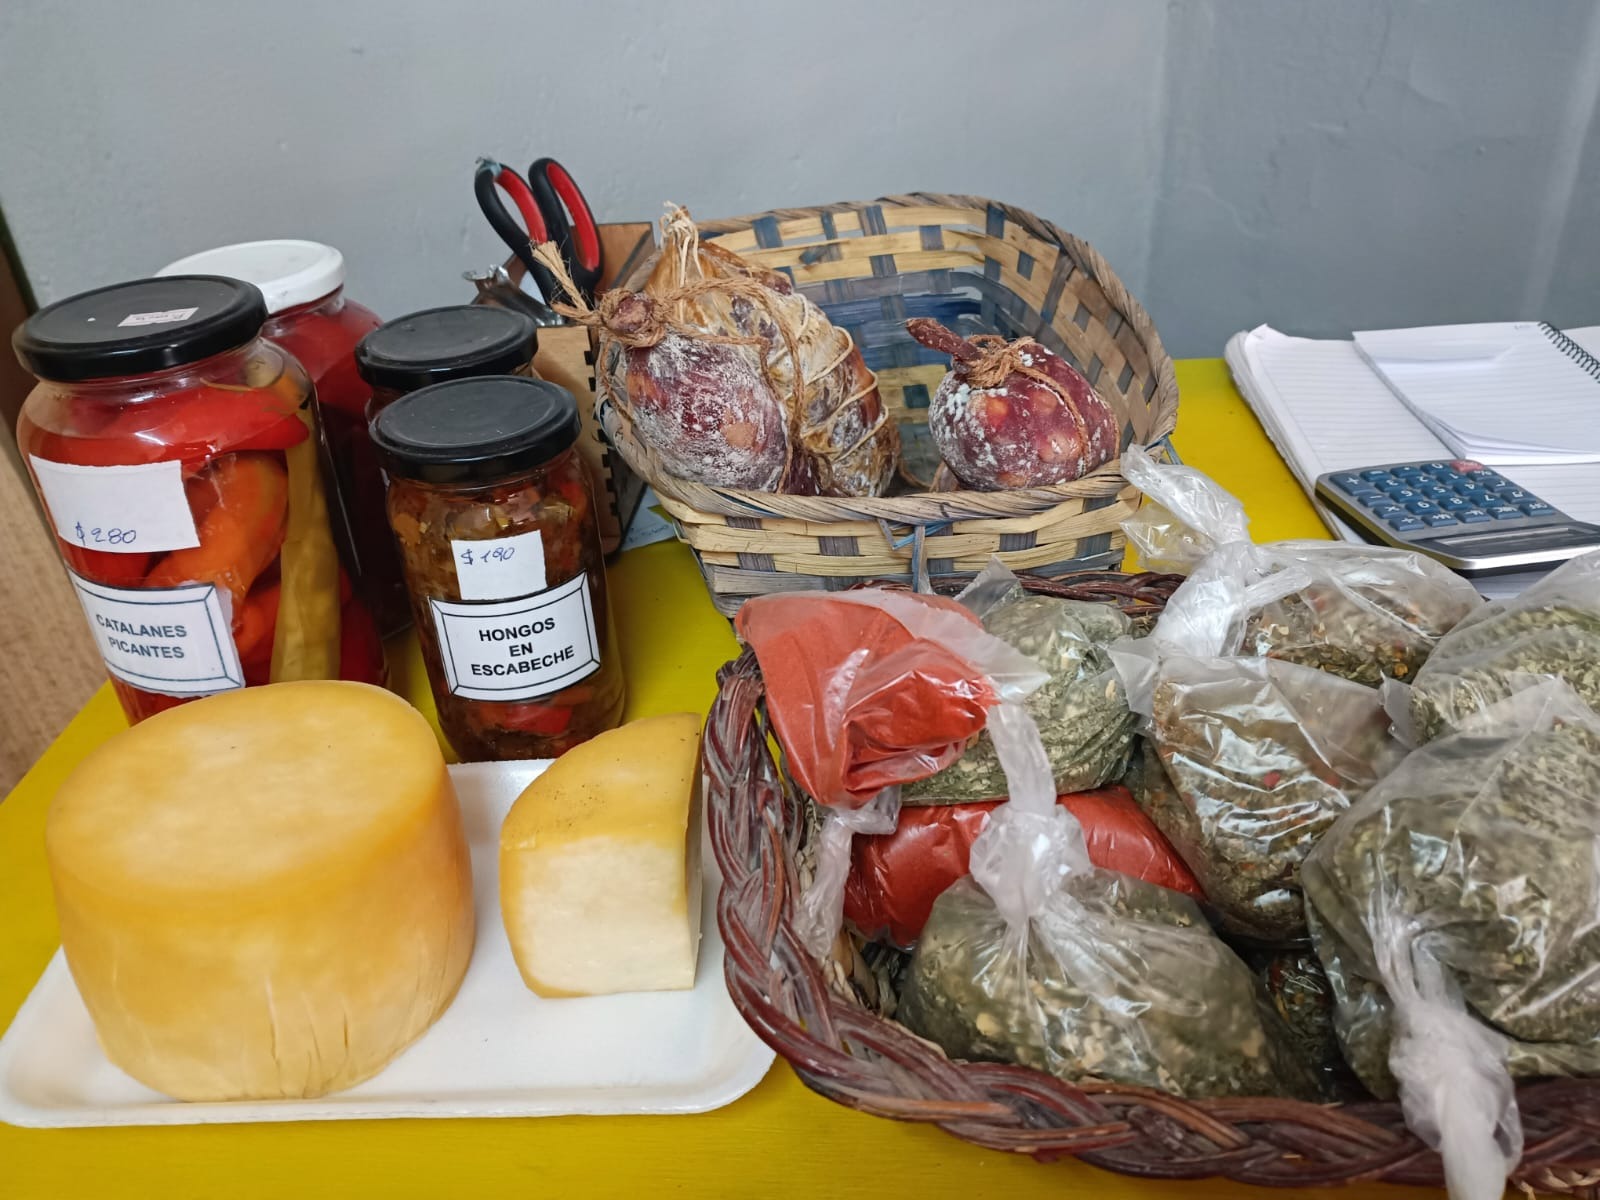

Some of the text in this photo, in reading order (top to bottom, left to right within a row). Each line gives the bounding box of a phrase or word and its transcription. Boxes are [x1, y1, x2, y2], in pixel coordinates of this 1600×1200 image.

[1464, 482, 1475, 490] 4
[1450, 497, 1463, 505] 8
[96, 614, 187, 638] CATALANES
[478, 617, 556, 642] HONGOS
[108, 636, 185, 659] PICANTES
[509, 642, 534, 658] EN
[471, 645, 575, 676] ESCABECHE
